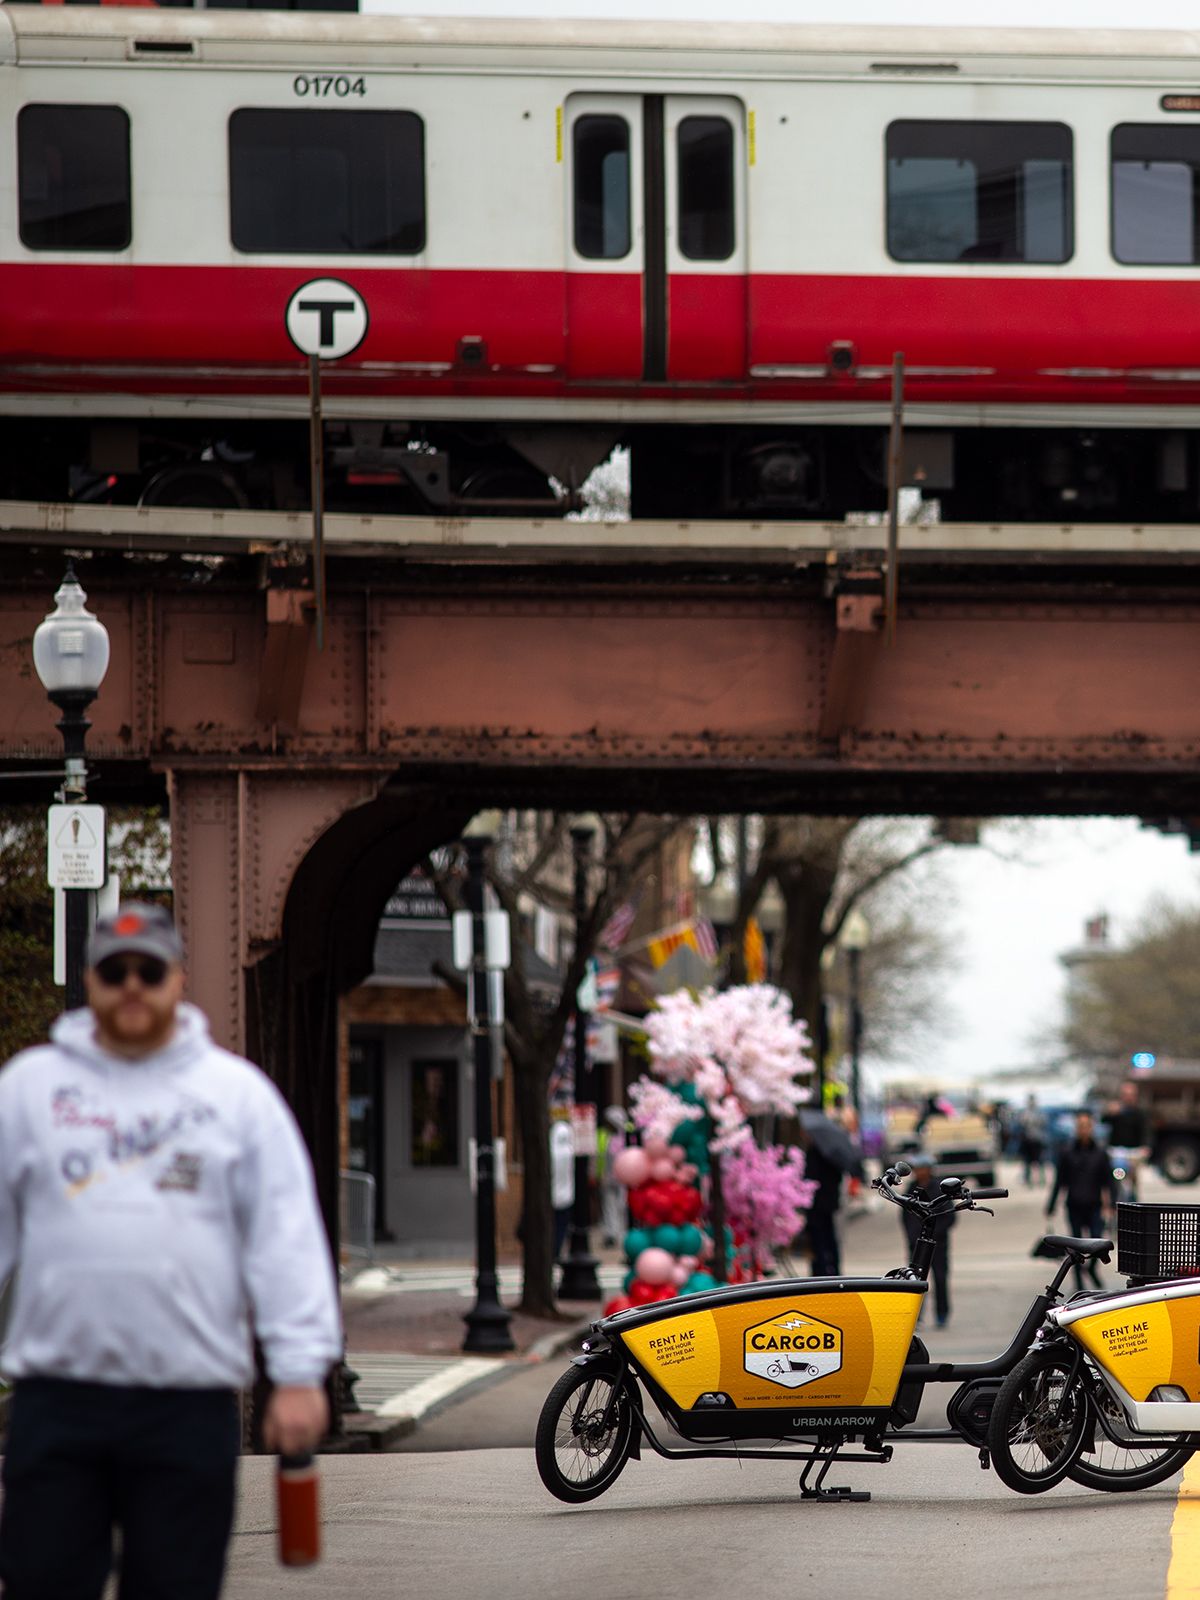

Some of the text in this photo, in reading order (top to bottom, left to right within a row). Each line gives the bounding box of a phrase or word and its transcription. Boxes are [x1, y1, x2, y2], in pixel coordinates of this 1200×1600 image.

[293, 74, 366, 97] 01704
[298, 301, 355, 348] T
[1102, 1322, 1149, 1339] RENT ME
[1128, 1333, 1145, 1341] HOUR
[649, 1330, 696, 1349] RENT ME
[675, 1341, 692, 1349] HOUR
[792, 1417, 875, 1426] URBAN ARROW
